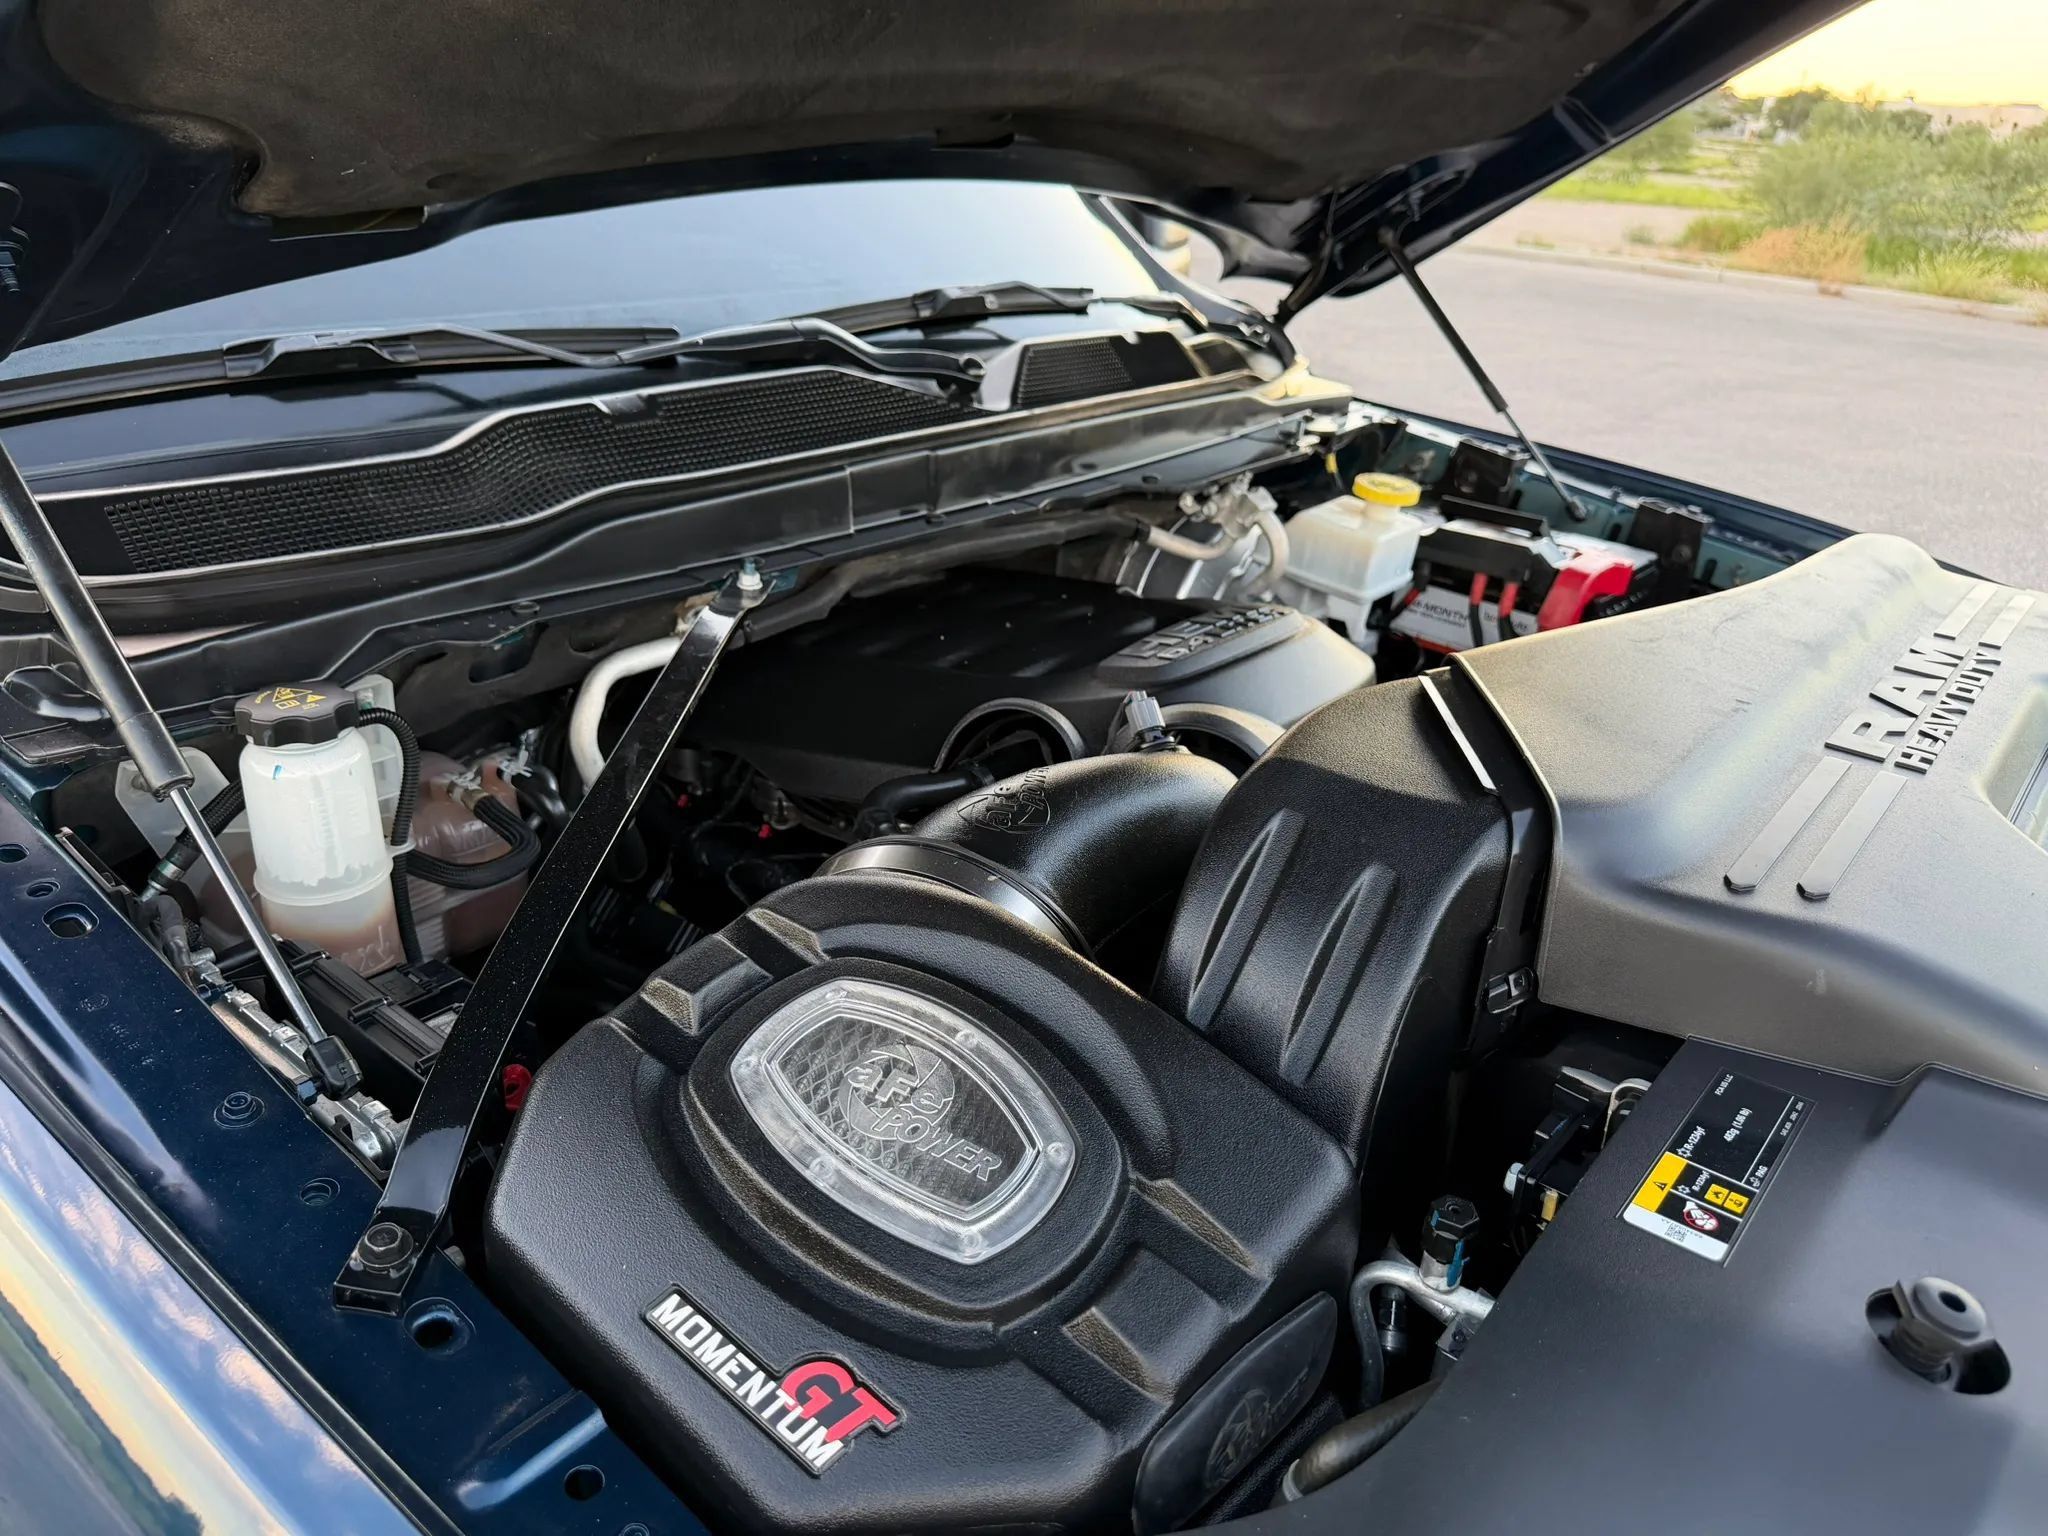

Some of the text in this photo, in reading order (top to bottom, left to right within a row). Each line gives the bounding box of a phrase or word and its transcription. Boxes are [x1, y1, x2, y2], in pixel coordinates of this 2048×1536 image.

[1825, 637, 1970, 762] RAM
[1894, 651, 2001, 774] HEAVY DUTY
[845, 1062, 944, 1114] aFe
[871, 1107, 1002, 1182] POWER
[1685, 1125, 1706, 1150] R-1234yf
[1755, 1165, 1768, 1178] PAG
[652, 1293, 843, 1467] MOMENTUM
[781, 1361, 896, 1442] GT
